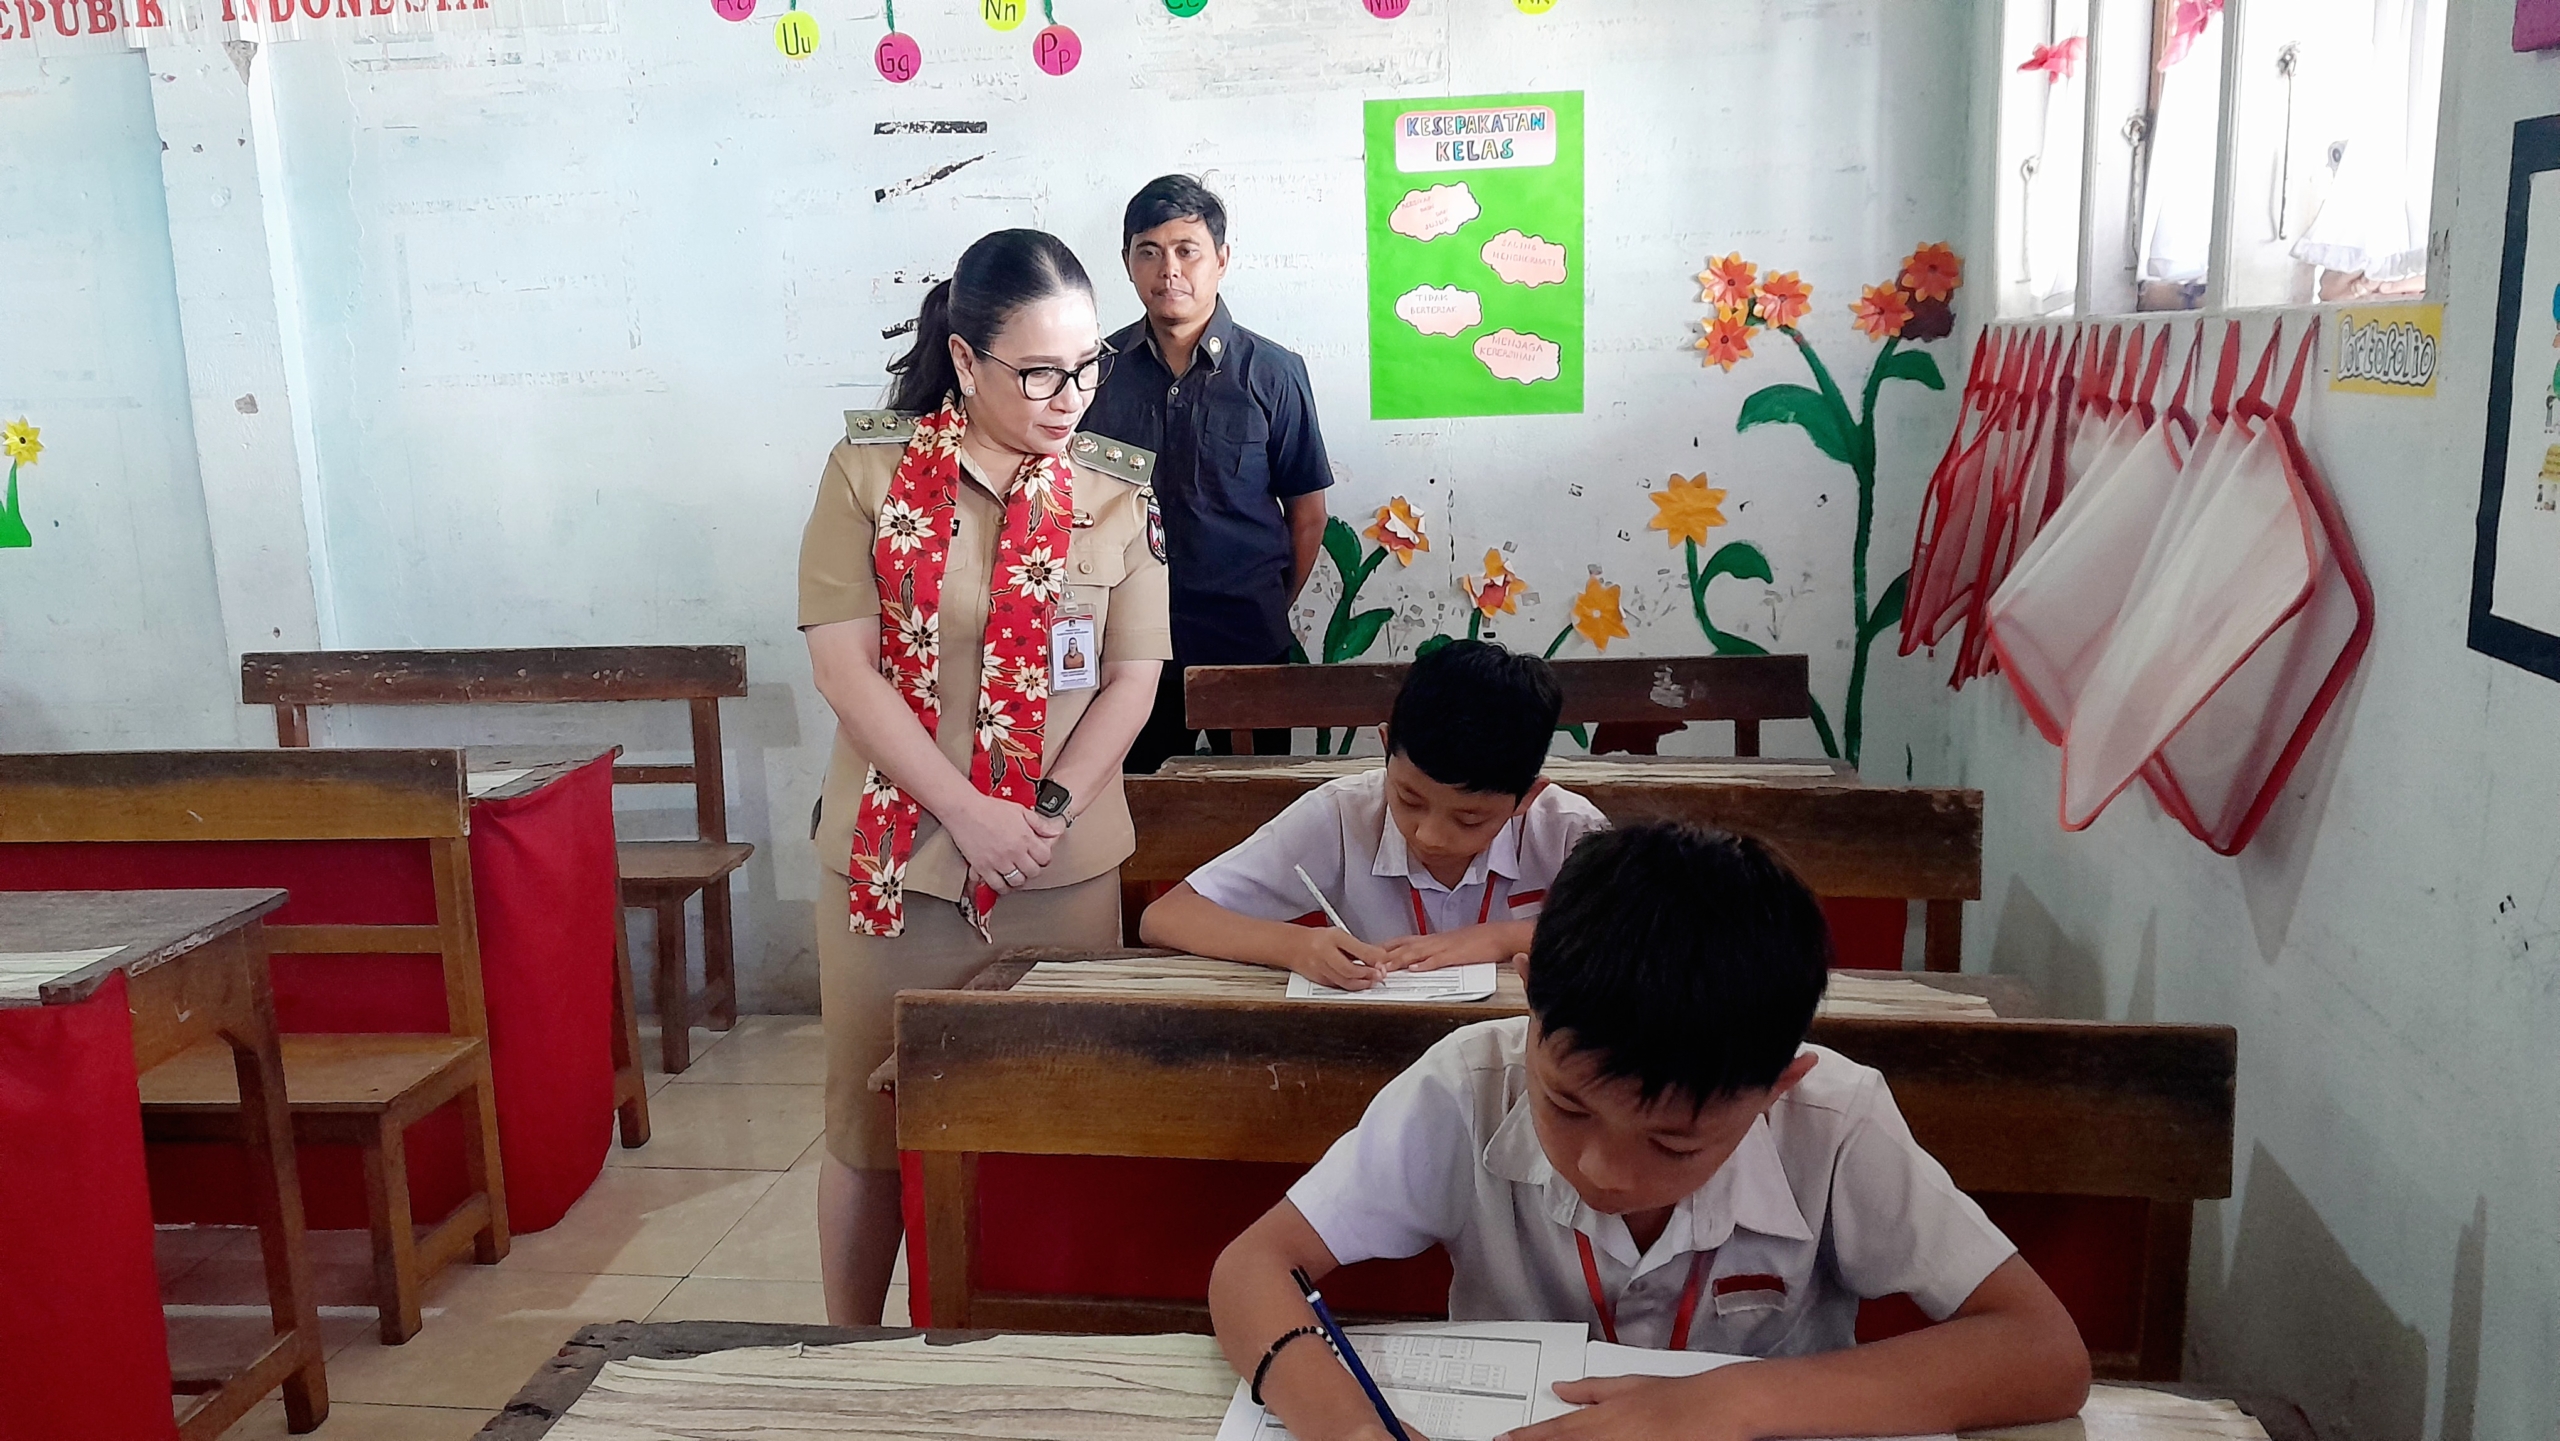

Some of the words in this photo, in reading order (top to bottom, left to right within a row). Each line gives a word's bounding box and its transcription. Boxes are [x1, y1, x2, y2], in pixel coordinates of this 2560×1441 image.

[782, 22, 811, 56] Uu
[879, 43, 910, 81] Gg
[1040, 33, 1071, 74] Pp
[1406, 112, 1546, 136] KESEPAKATAN
[1436, 138, 1514, 162] KELAS
[1424, 216, 1450, 231] JUJUR
[1501, 238, 1537, 251] SALING
[1415, 293, 1448, 302] TIDAK
[1410, 305, 1457, 315] BERTERIAK
[1492, 335, 1544, 352] MENJAGA
[2338, 316, 2436, 386] Portofolio
